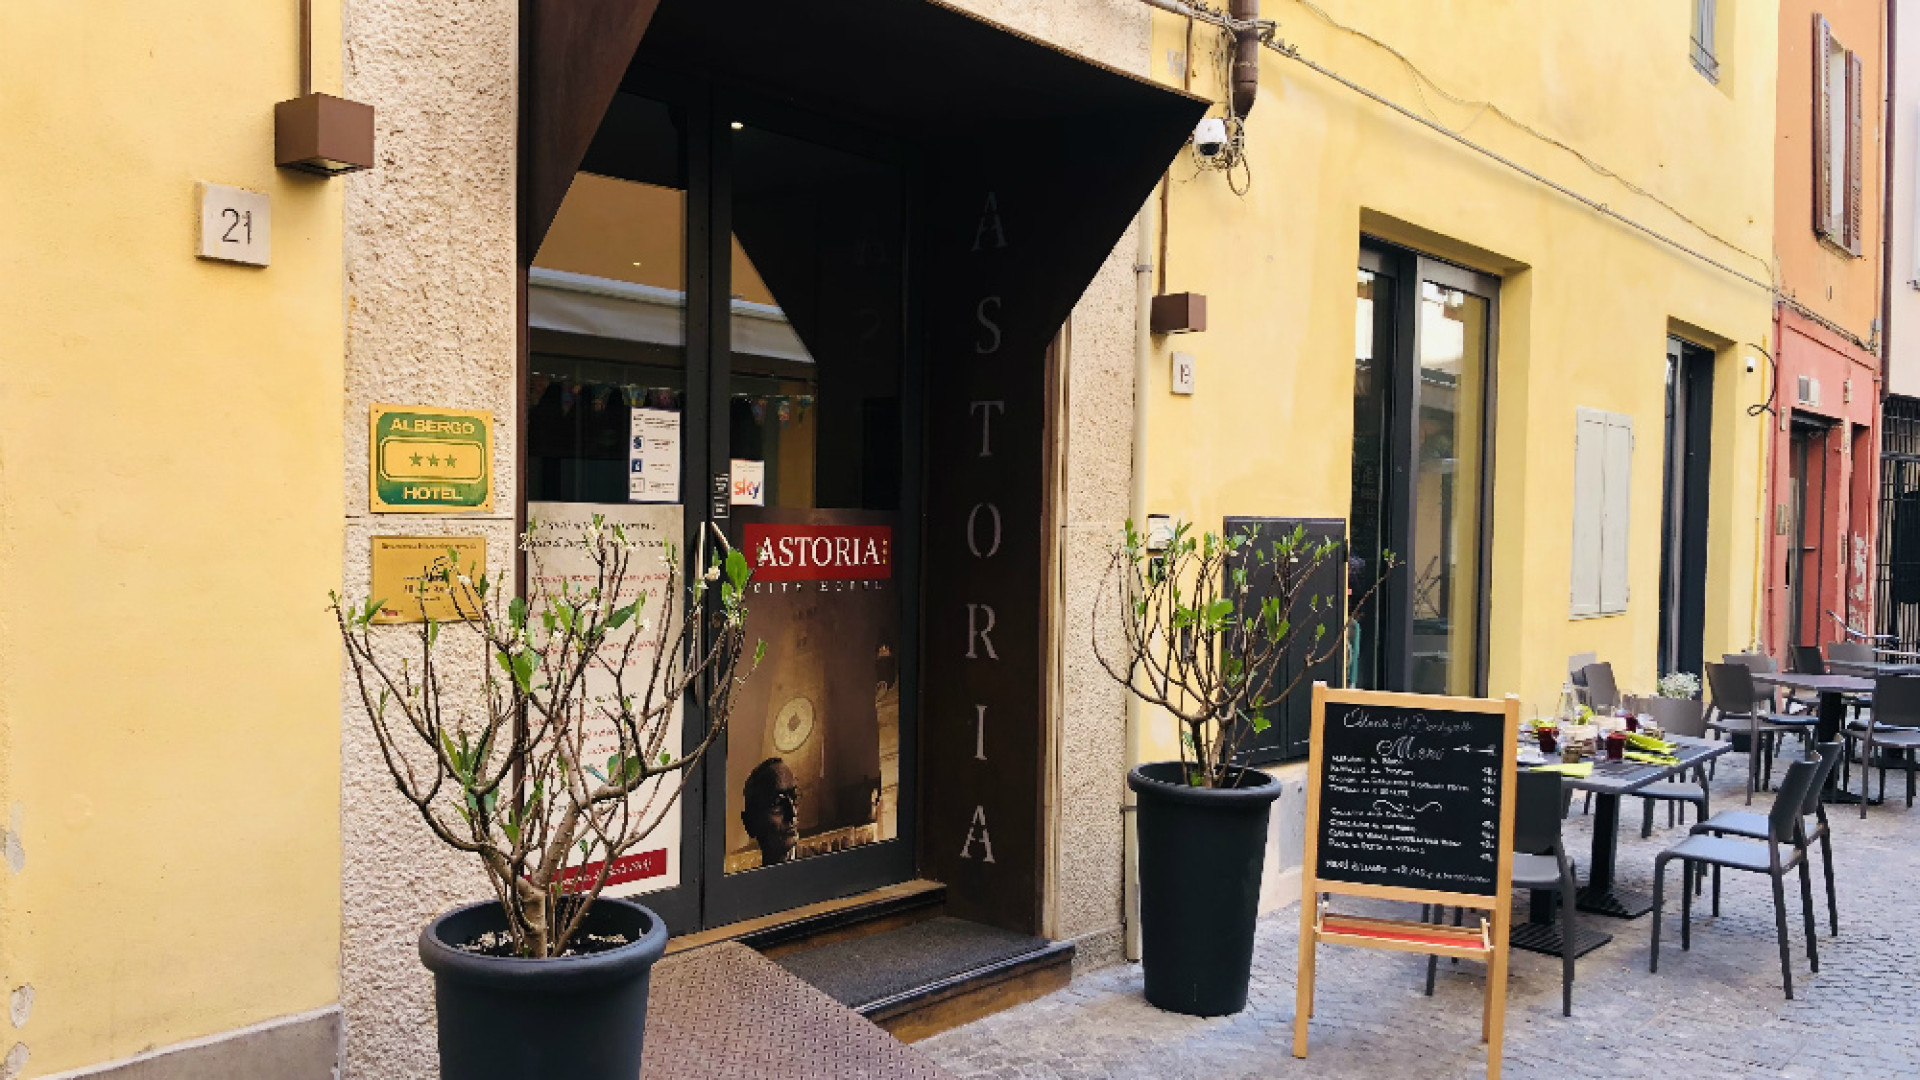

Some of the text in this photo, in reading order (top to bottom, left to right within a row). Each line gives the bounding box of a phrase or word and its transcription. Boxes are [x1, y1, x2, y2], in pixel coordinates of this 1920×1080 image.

[220, 208, 254, 245] 21
[389, 418, 475, 435] ALBERGO
[403, 487, 463, 500] HOTEL
[734, 476, 761, 499] sky
[960, 191, 1009, 865] ASTORIA
[757, 536, 880, 567] ASTORIA
